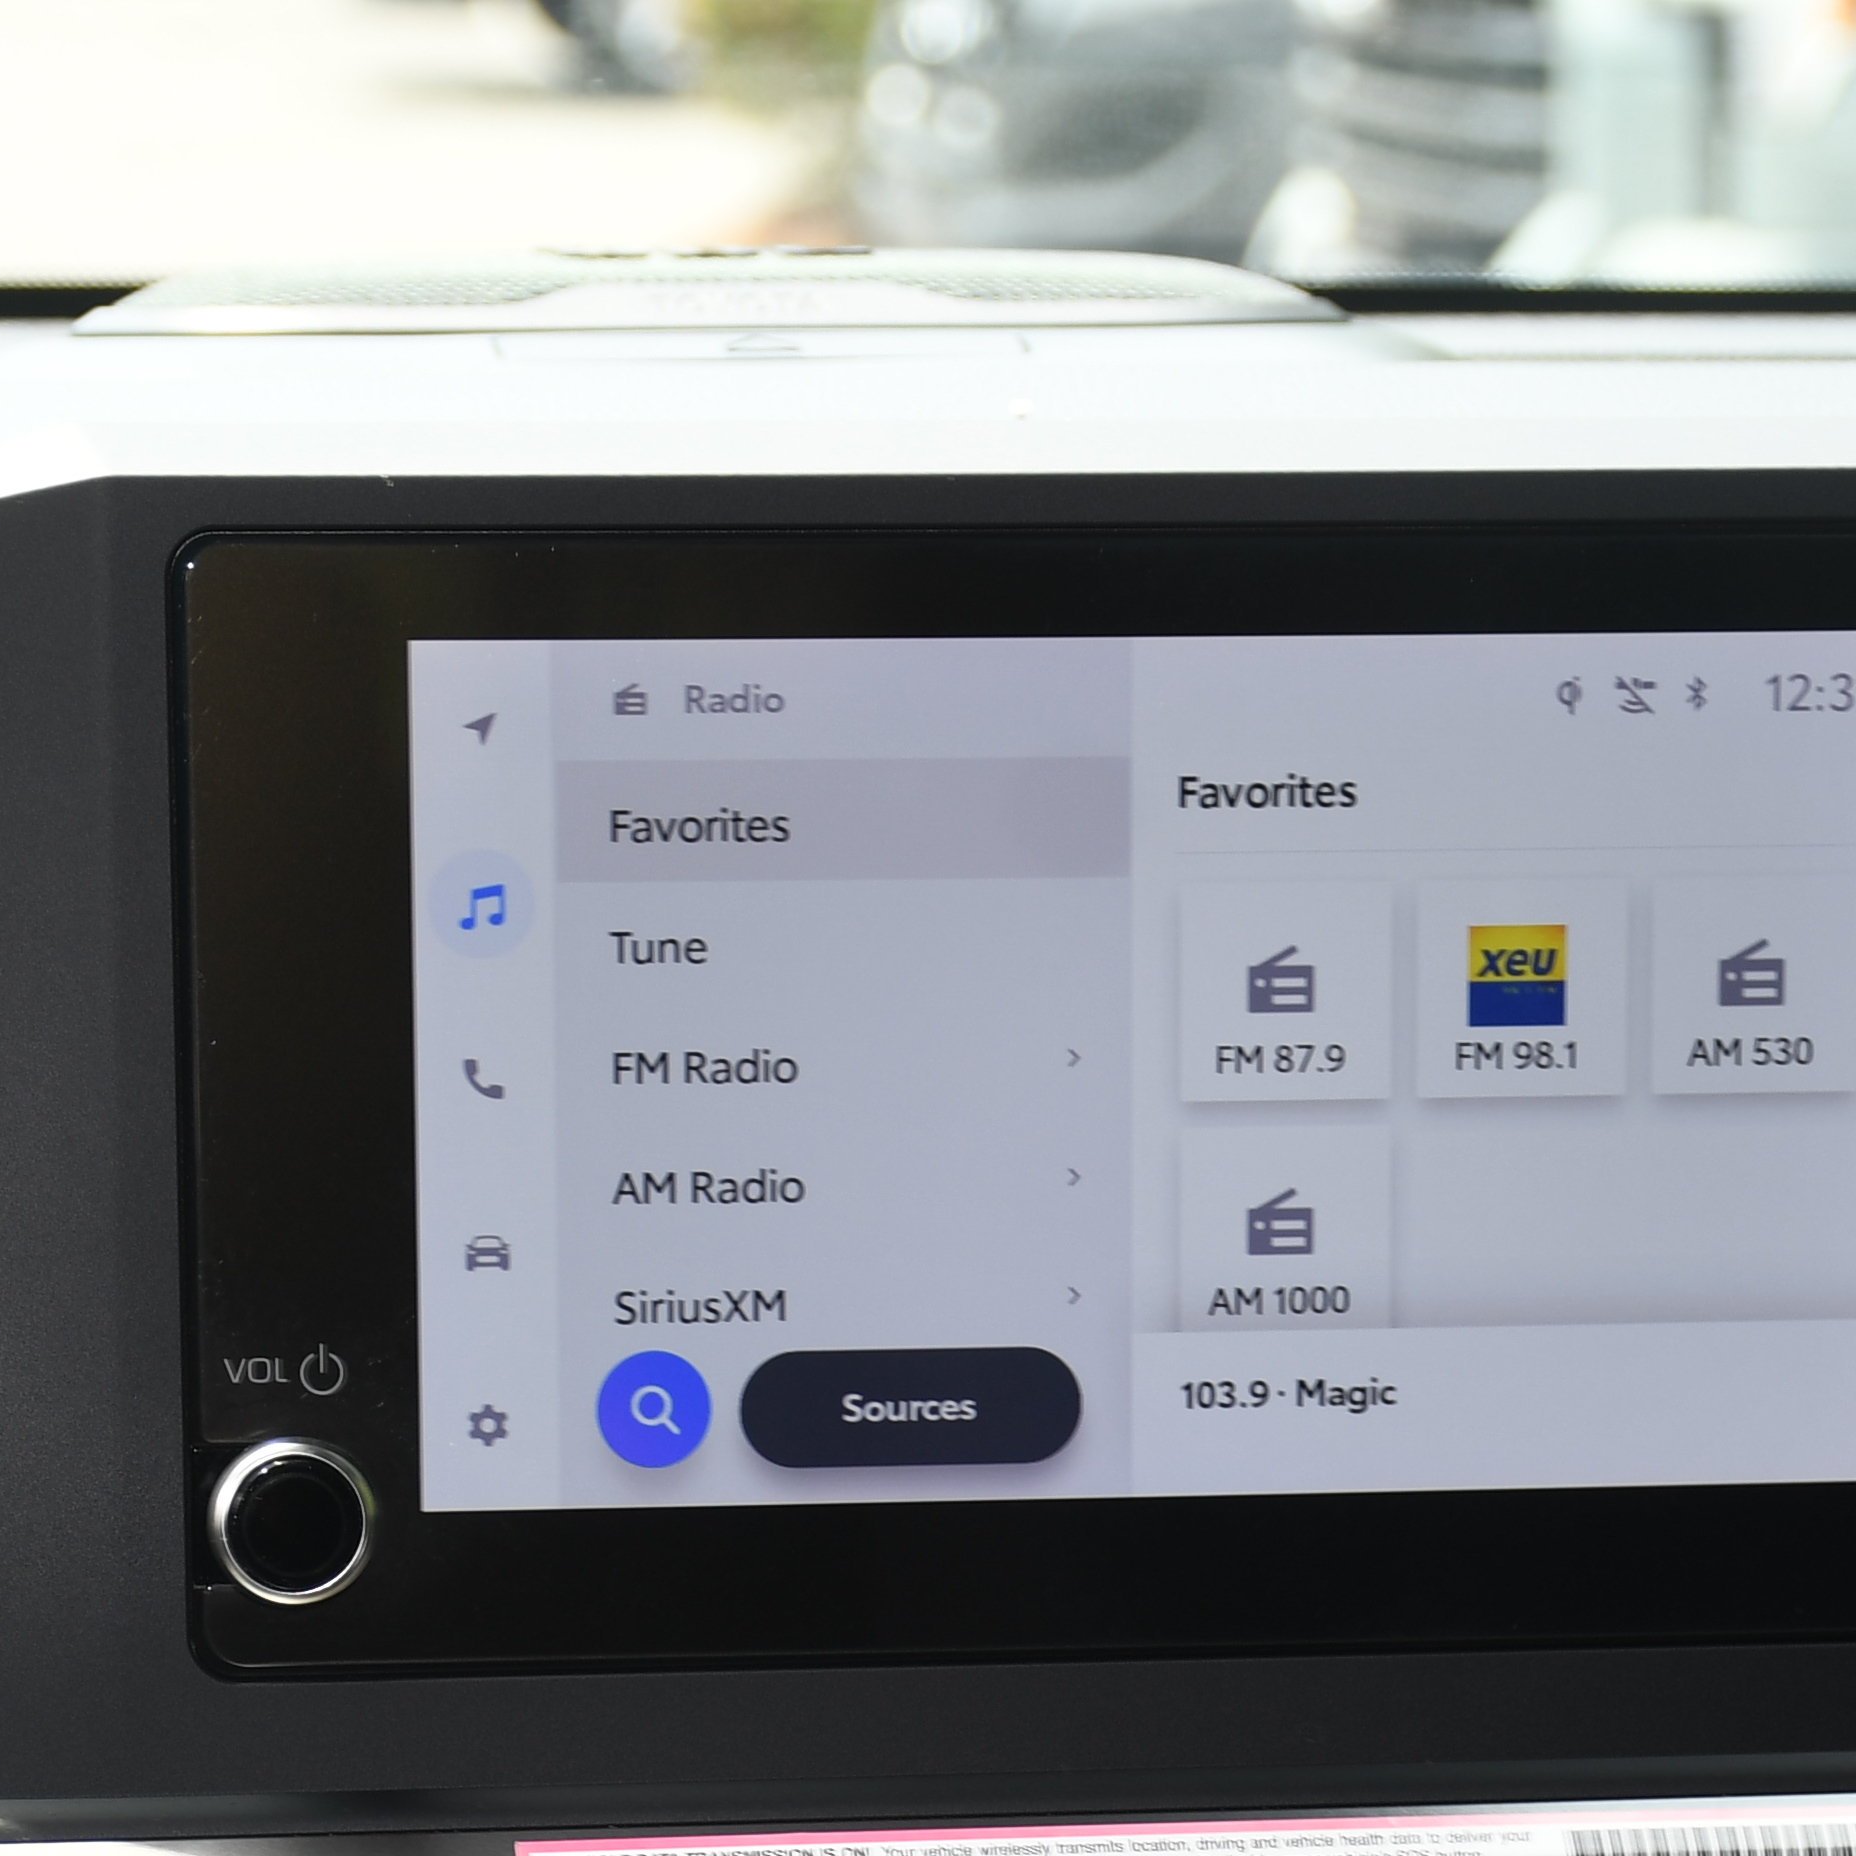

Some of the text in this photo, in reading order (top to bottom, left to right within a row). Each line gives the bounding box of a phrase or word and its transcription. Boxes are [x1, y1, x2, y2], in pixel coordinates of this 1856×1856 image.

[685, 683, 784, 714] Radio
[1179, 773, 1357, 809] Favorites
[610, 807, 789, 844] Favorites
[609, 931, 708, 965] Tune
[1476, 946, 1557, 978] xeu
[613, 1048, 798, 1085] FM Radio
[1216, 1044, 1345, 1074] FM 87.9
[1456, 1041, 1576, 1070] FM 98.1
[1688, 1037, 1813, 1067] AM 530
[612, 1168, 805, 1205] AM Radio
[615, 1289, 786, 1326] SiriusXM
[1208, 1285, 1350, 1316] AM 1000
[223, 1357, 288, 1384] VOL
[842, 1393, 977, 1423] Sources
[1181, 1377, 1397, 1414] 103.9 Magic
[1056, 1840, 1123, 1854] transmits
[1196, 1837, 1244, 1853] driving
[1253, 1836, 1277, 1848] and
[1285, 1834, 1333, 1847] vehicle
[1339, 1832, 1383, 1845] health
[1390, 1831, 1420, 1844] data
